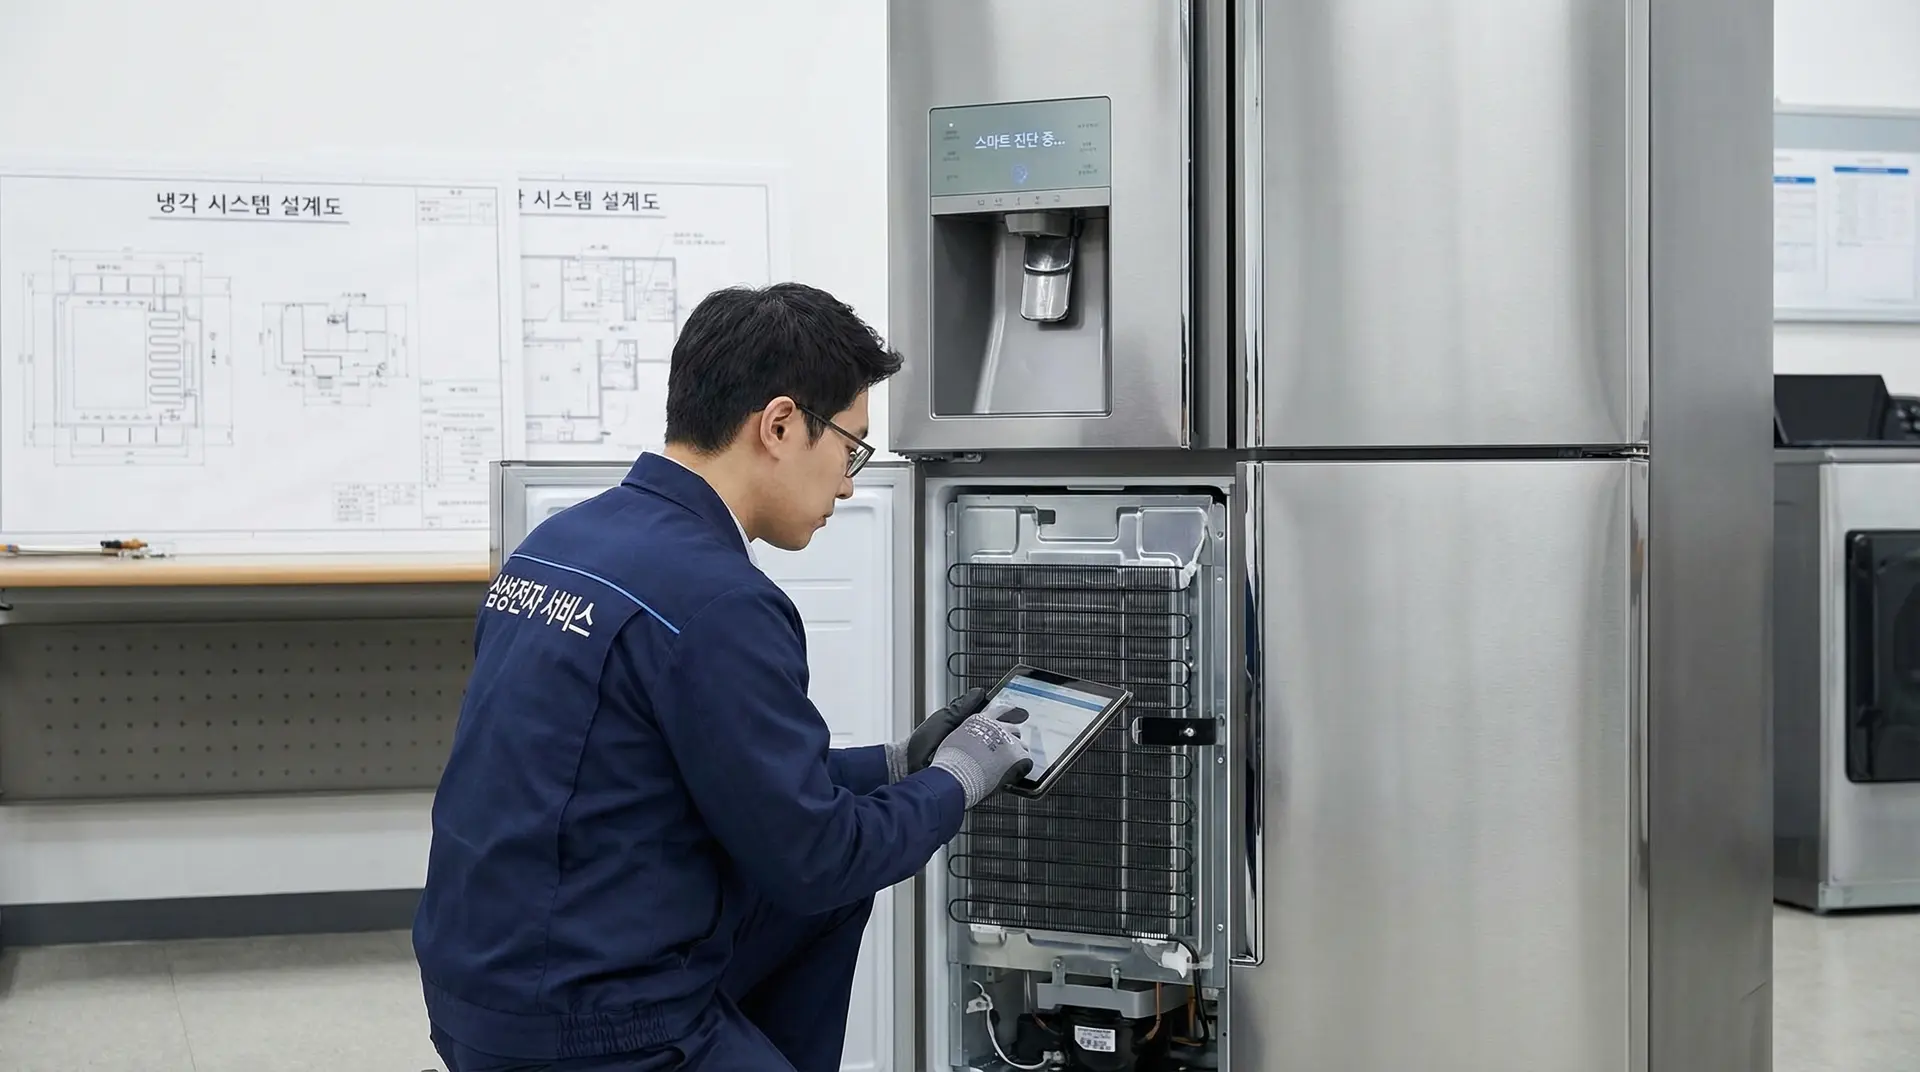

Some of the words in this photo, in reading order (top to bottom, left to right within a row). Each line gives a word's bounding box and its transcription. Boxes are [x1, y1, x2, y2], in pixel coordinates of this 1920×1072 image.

[974, 135, 1011, 150] 스마트
[1014, 133, 1039, 149] 진단
[157, 192, 198, 214] 냉각
[208, 194, 270, 216] 시스템
[281, 195, 343, 217] 설계도
[534, 189, 592, 211] 시스템
[602, 191, 661, 212] 설계도
[485, 573, 549, 619] 삼성전자
[540, 589, 595, 638] 서비스
